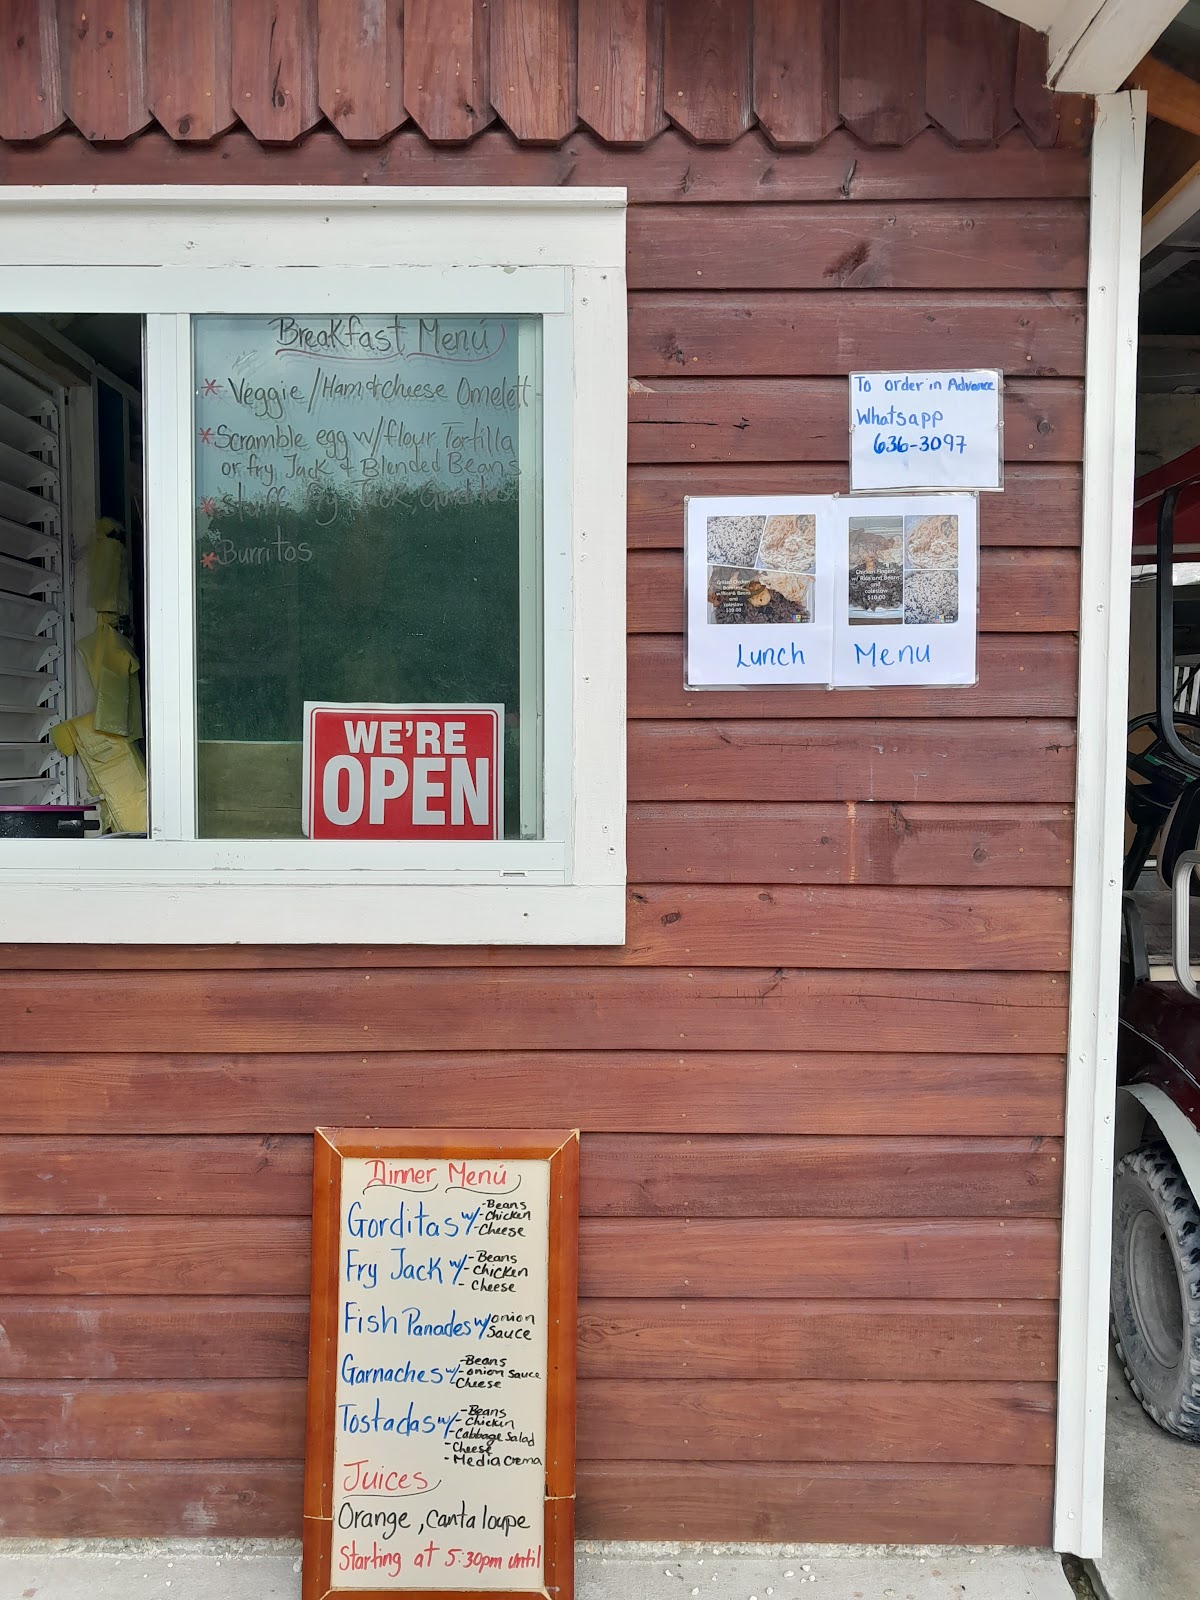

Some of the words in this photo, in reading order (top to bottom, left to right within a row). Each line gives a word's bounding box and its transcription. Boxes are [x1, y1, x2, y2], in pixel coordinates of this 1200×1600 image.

[854, 376, 872, 392] To
[926, 378, 942, 391] in
[948, 377, 995, 391] Advance
[857, 405, 943, 429] Whatsapp
[214, 424, 308, 452] Scramble
[316, 428, 348, 460] egg
[442, 418, 515, 454] Tortilla
[874, 433, 967, 454] 636-3097
[221, 461, 238, 476] or
[247, 455, 274, 486] fry
[284, 454, 334, 482] Jack
[360, 446, 440, 477] Blended
[448, 451, 522, 477] Beans
[216, 525, 312, 565] Burritos
[737, 642, 805, 668] Lunch
[855, 643, 930, 667] Menu
[344, 720, 466, 755] WE'RE
[323, 754, 489, 826] OPEN
[365, 1160, 437, 1186] Dinner
[348, 1201, 458, 1238] Gorditas
[461, 1206, 481, 1235] w/
[346, 1249, 377, 1289] Fry
[391, 1248, 443, 1284] Jack
[449, 1254, 468, 1285] w/
[344, 1302, 397, 1334] Fish
[401, 1307, 471, 1337] Panades
[341, 1353, 443, 1386] Garnaches
[339, 1398, 436, 1436] Tostadas
[343, 1460, 428, 1491] Juices
[338, 1502, 411, 1540] Orange
[339, 1541, 401, 1577] Starting
[414, 1541, 440, 1567] at
[445, 1549, 502, 1573] 5:30pm
[508, 1545, 541, 1569] until
